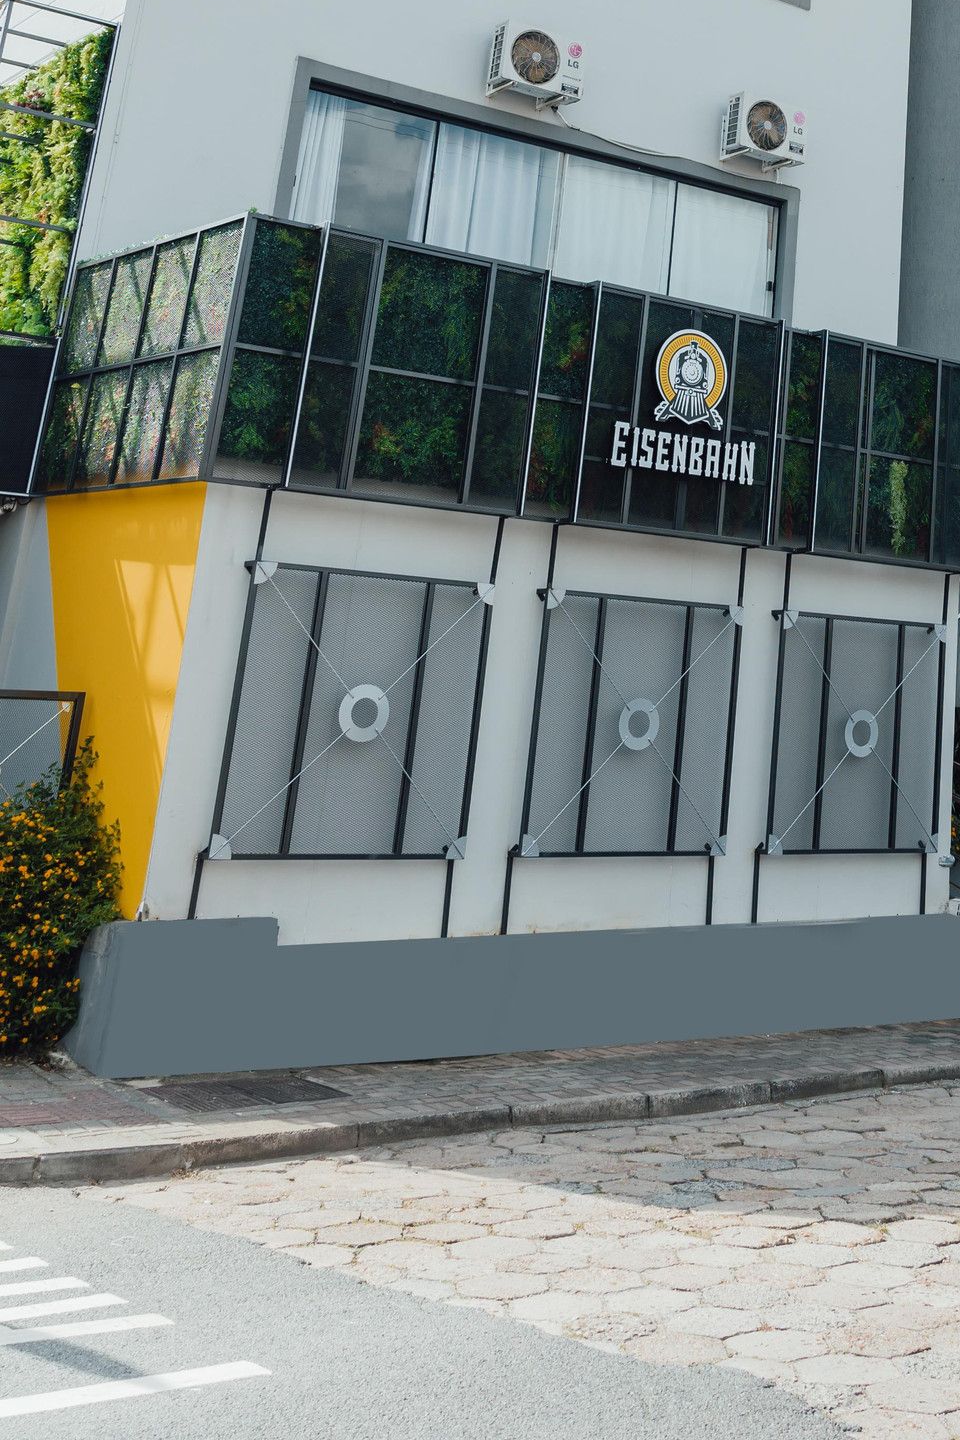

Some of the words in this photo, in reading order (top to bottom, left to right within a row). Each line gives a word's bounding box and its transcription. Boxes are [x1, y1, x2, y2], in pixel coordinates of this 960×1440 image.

[567, 60, 579, 69] LG
[793, 126, 803, 136] LG
[611, 421, 756, 486] EISENBAHN
